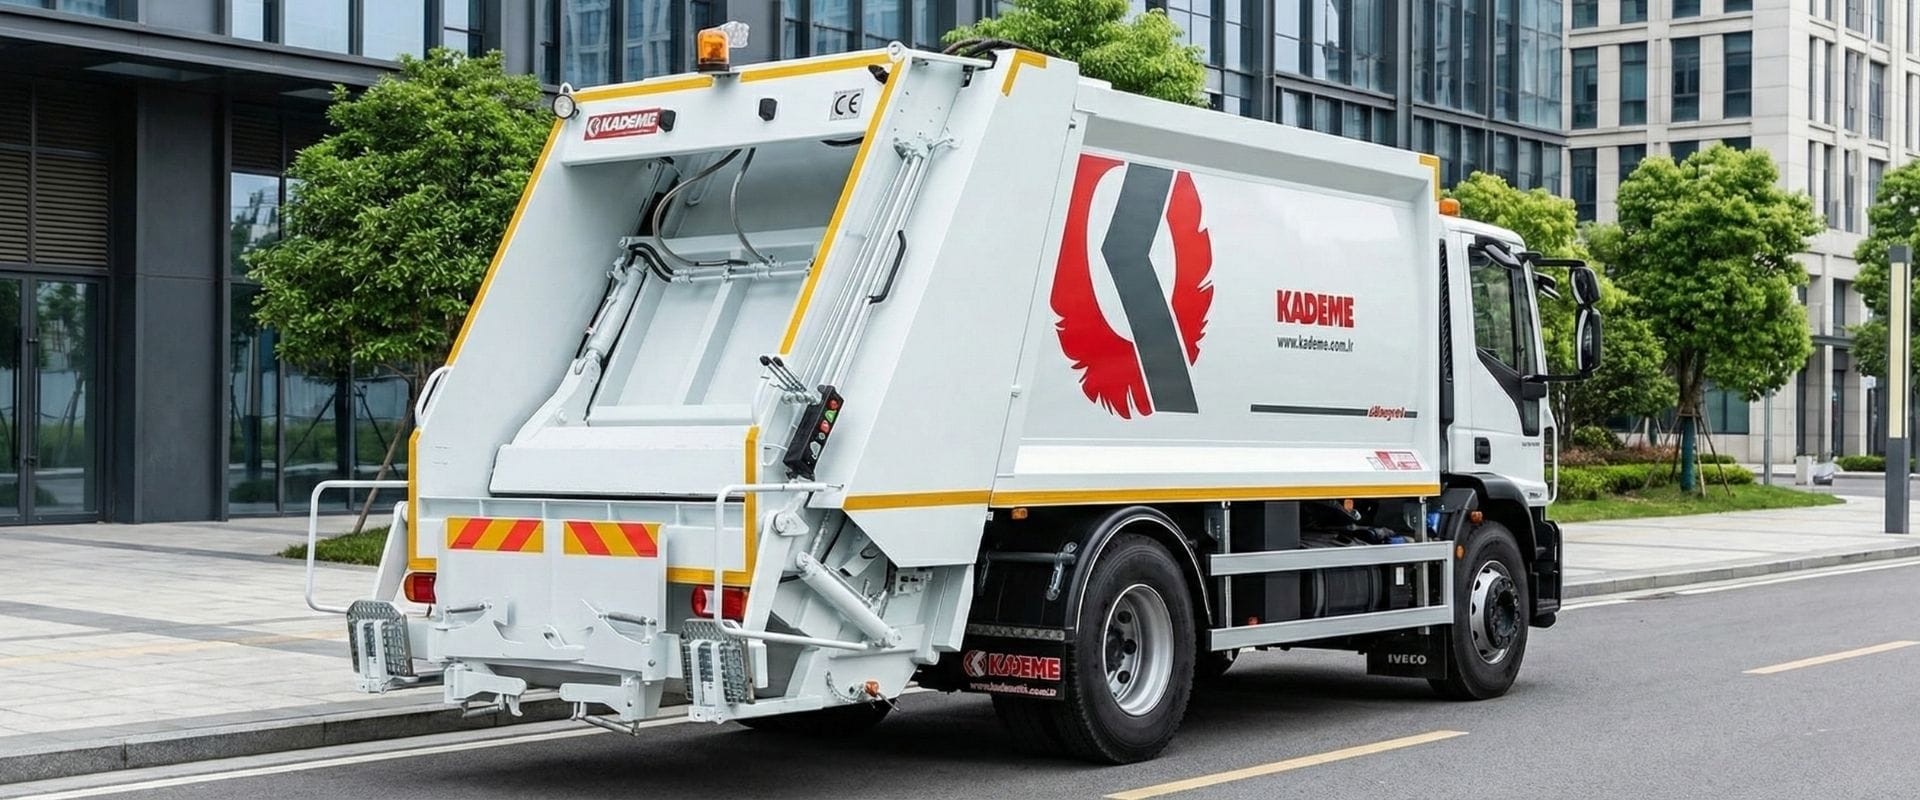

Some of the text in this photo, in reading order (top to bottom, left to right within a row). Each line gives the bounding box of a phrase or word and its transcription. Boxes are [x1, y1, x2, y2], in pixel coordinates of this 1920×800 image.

[1277, 290, 1354, 328] KADEME
[988, 653, 1060, 680] KADEME
[1387, 653, 1427, 665] IVECO
